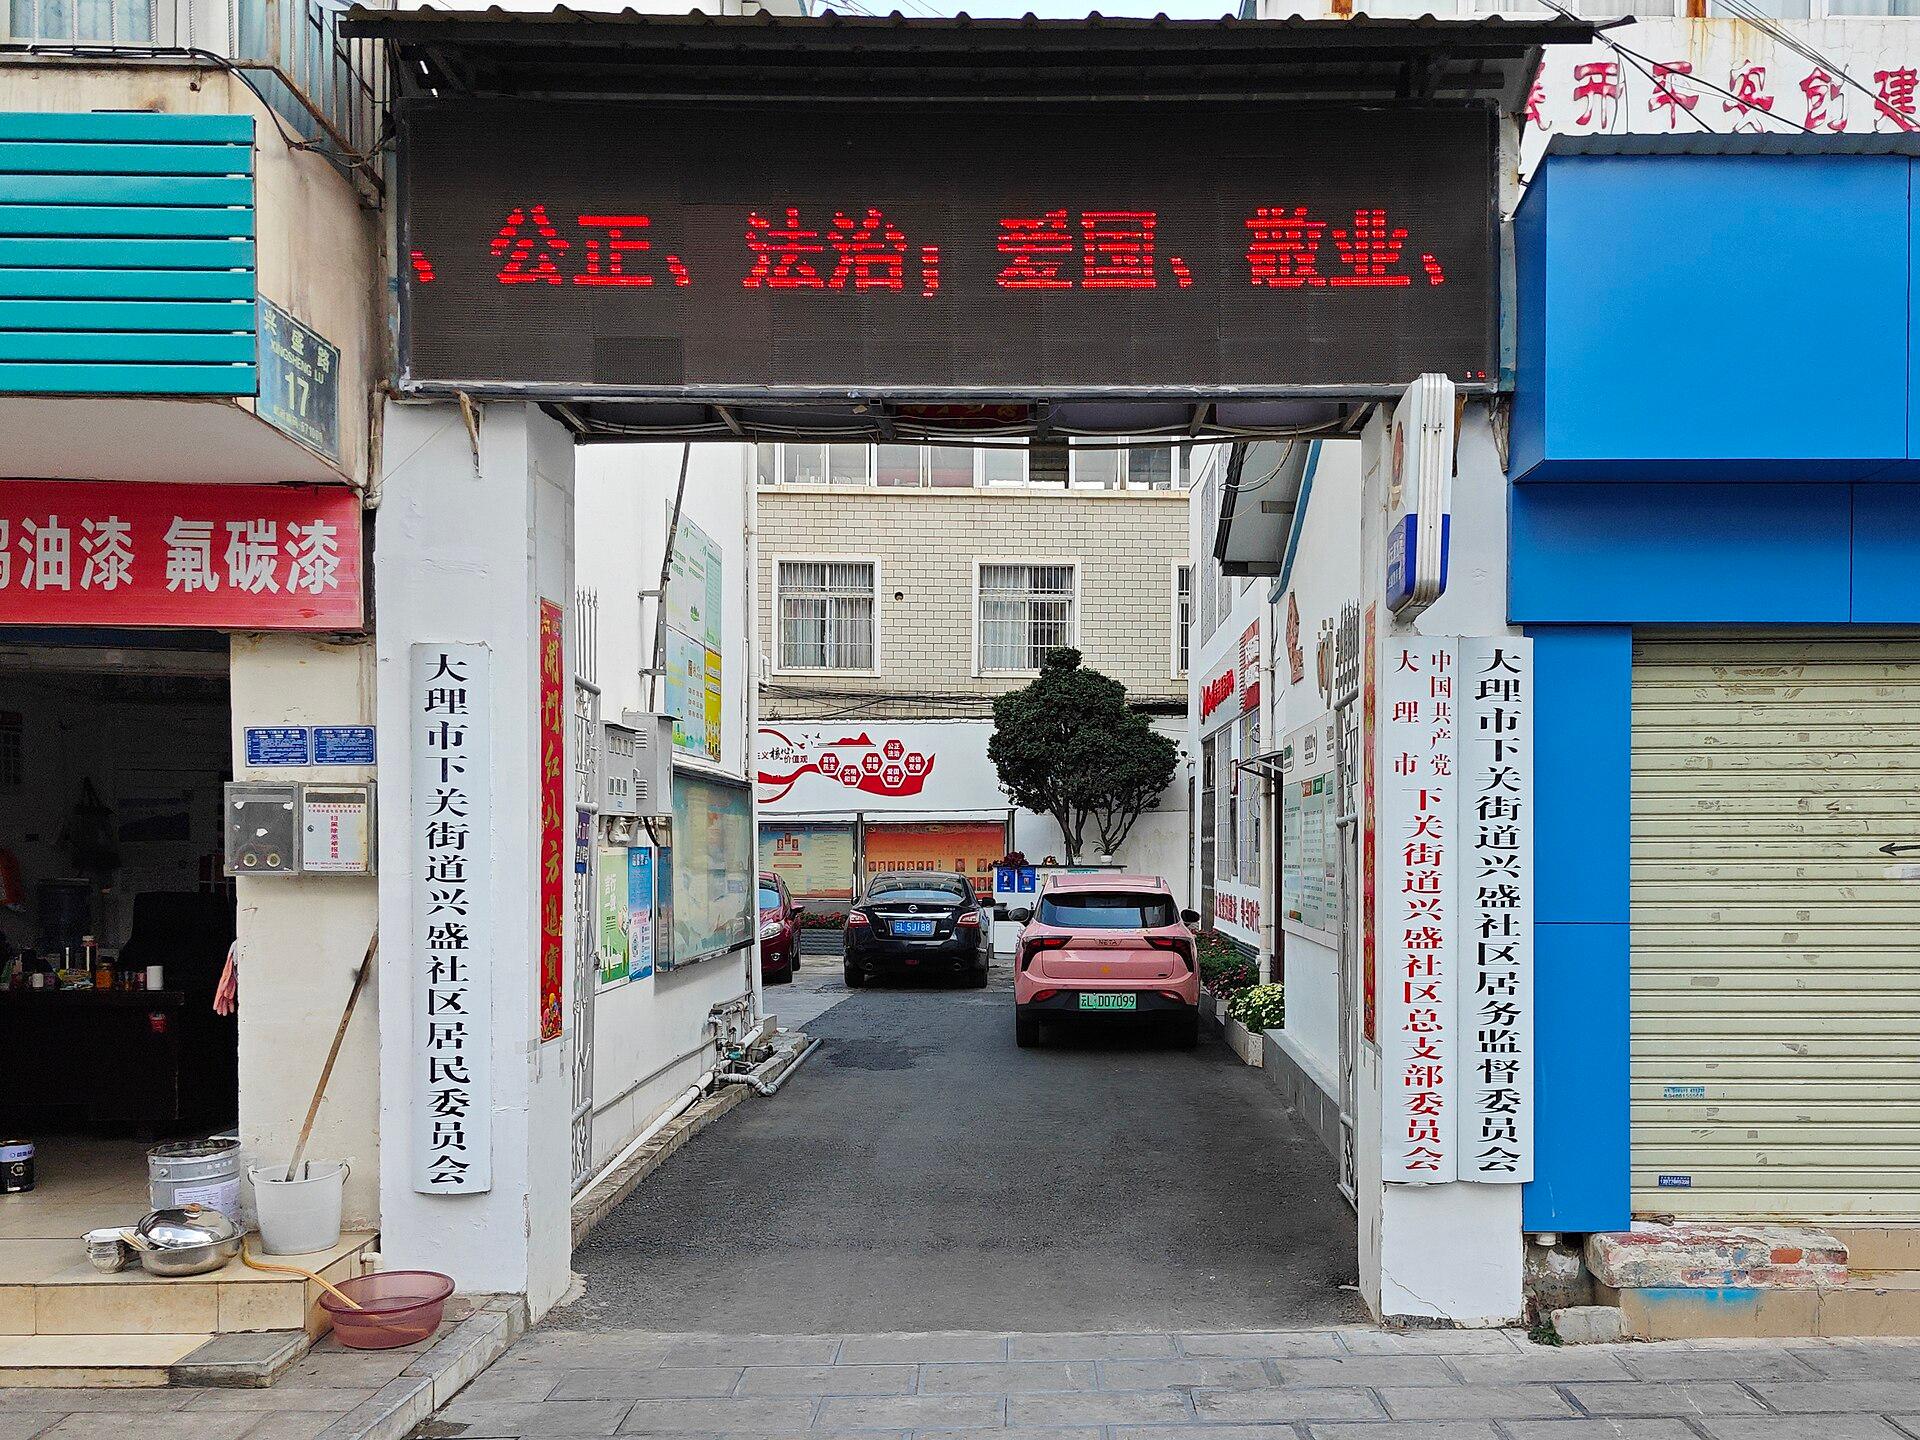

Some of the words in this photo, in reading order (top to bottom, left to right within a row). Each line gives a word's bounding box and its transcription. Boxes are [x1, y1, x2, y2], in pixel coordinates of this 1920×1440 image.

[264, 307, 330, 374] 兴盛路
[285, 371, 309, 417] 17
[163, 516, 341, 595] 氟碳漆
[1393, 649, 1420, 778] 大理市
[1430, 649, 1452, 779] 中国共产党
[425, 653, 471, 1185] 大理市下关街道兴盛社区居民委员会
[1474, 648, 1522, 1172] 大理市下关街道兴盛社区居务监督委员会
[1402, 787, 1444, 1172] 下关街道兴盛社区总支部委员会
